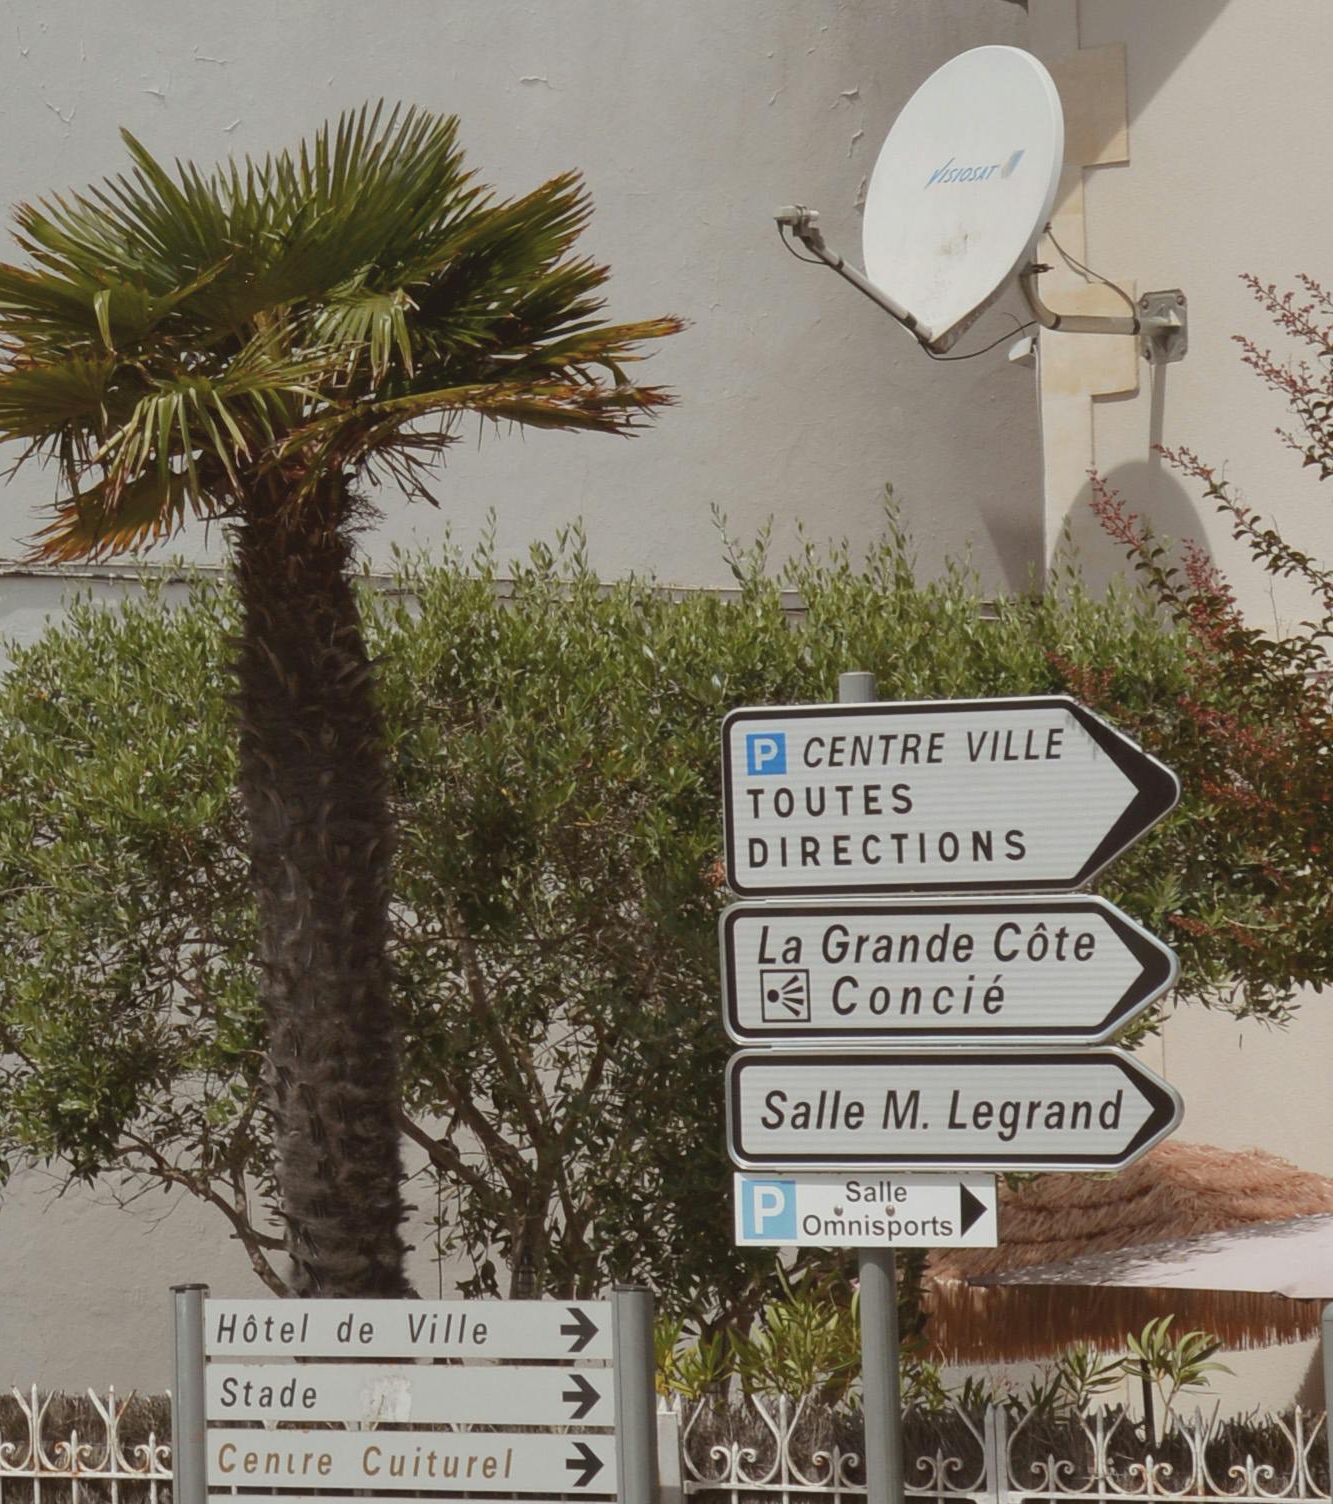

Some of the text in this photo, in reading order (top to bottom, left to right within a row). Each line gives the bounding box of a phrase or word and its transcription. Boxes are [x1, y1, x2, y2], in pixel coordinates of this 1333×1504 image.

[924, 157, 1000, 190] VISIOSAT
[804, 733, 944, 767] CENTRE
[967, 728, 1063, 762] VILLE
[747, 784, 912, 818] TOUTES
[749, 830, 1025, 868] DIRECTIONS
[758, 922, 1095, 964] La Grande Côte
[832, 975, 1004, 1015] Concié
[761, 1090, 1123, 1141] Salle M. Legrand
[845, 1181, 907, 1203] Salle
[802, 1214, 953, 1242] Omnisports
[217, 1314, 487, 1344] Hôtel de Ville
[221, 1378, 316, 1408] Stade
